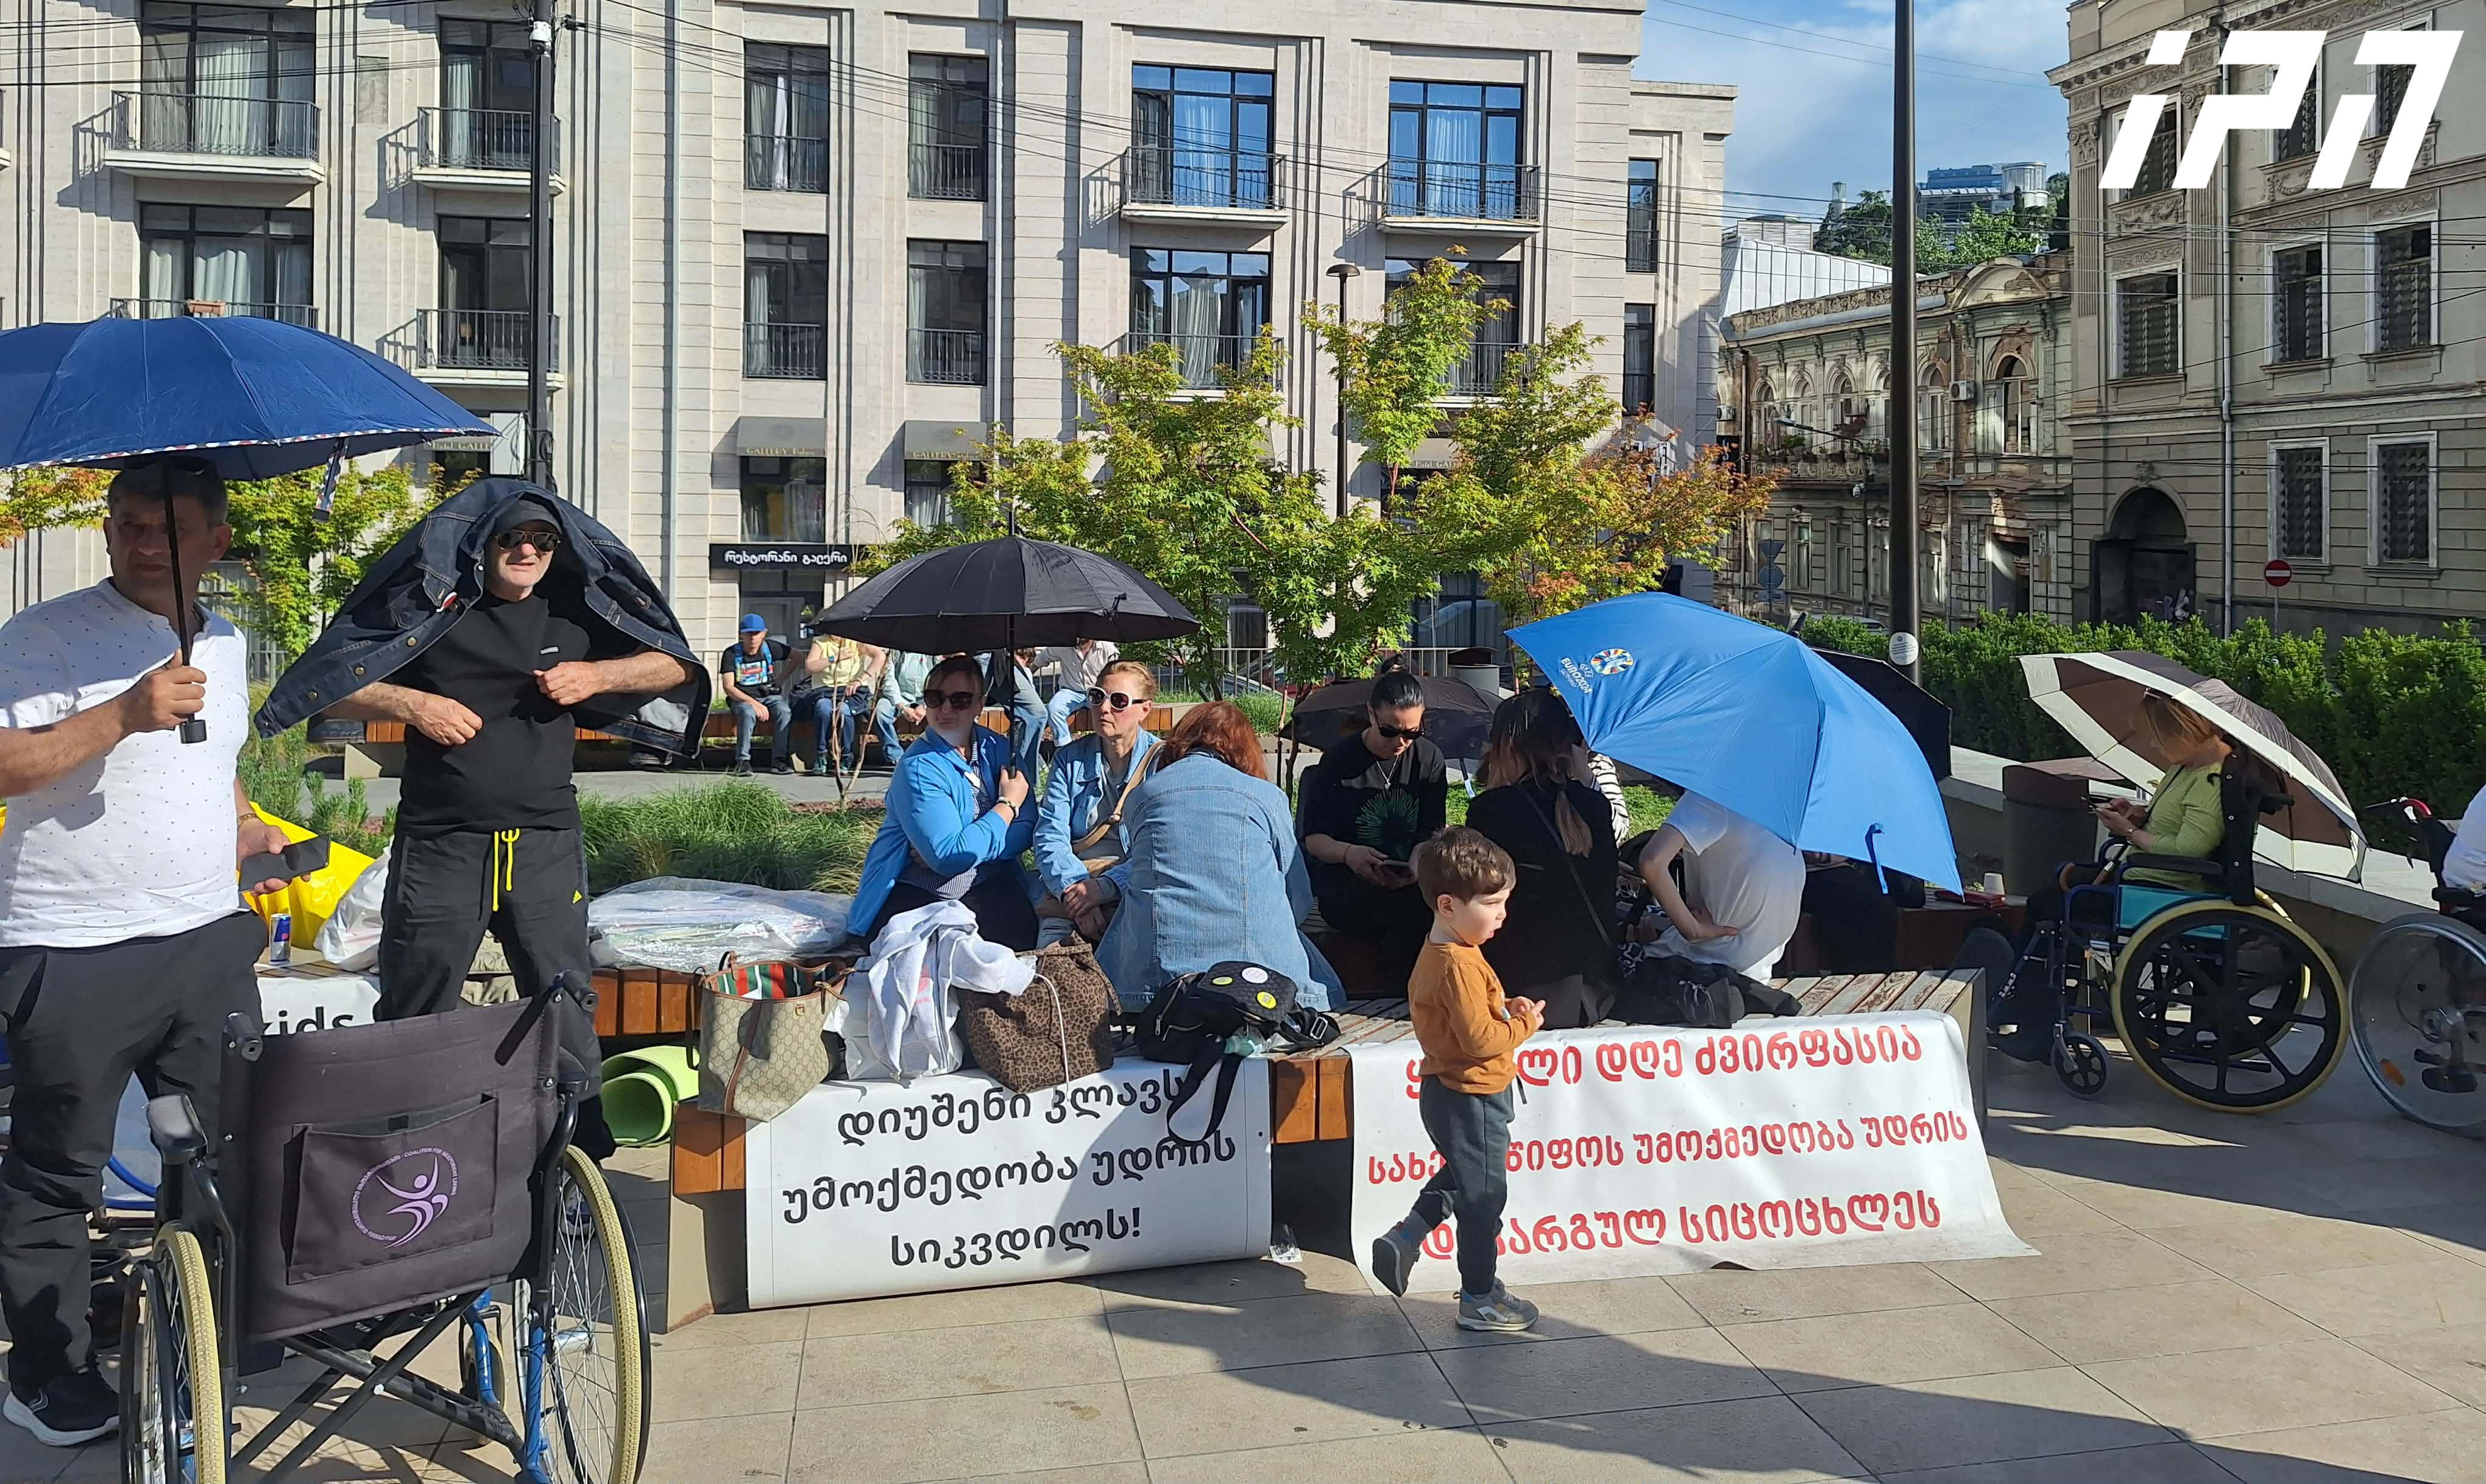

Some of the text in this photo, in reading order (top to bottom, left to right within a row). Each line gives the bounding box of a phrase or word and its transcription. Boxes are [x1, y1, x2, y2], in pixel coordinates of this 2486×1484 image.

[724, 550, 798, 565] რესტორანი
[1596, 1039, 1682, 1083] დღე
[1696, 1024, 1921, 1075] ძვირფასია
[838, 1087, 1031, 1147] დიუშენი
[1633, 1120, 1854, 1165] უმოქმედობა
[1861, 1111, 1967, 1148] უდრის
[782, 1129, 1236, 1224] უმოქმედობა უდრის
[891, 1207, 1140, 1269] სიკვდილს!
[1679, 1190, 1940, 1243] სიცოცხლეს
